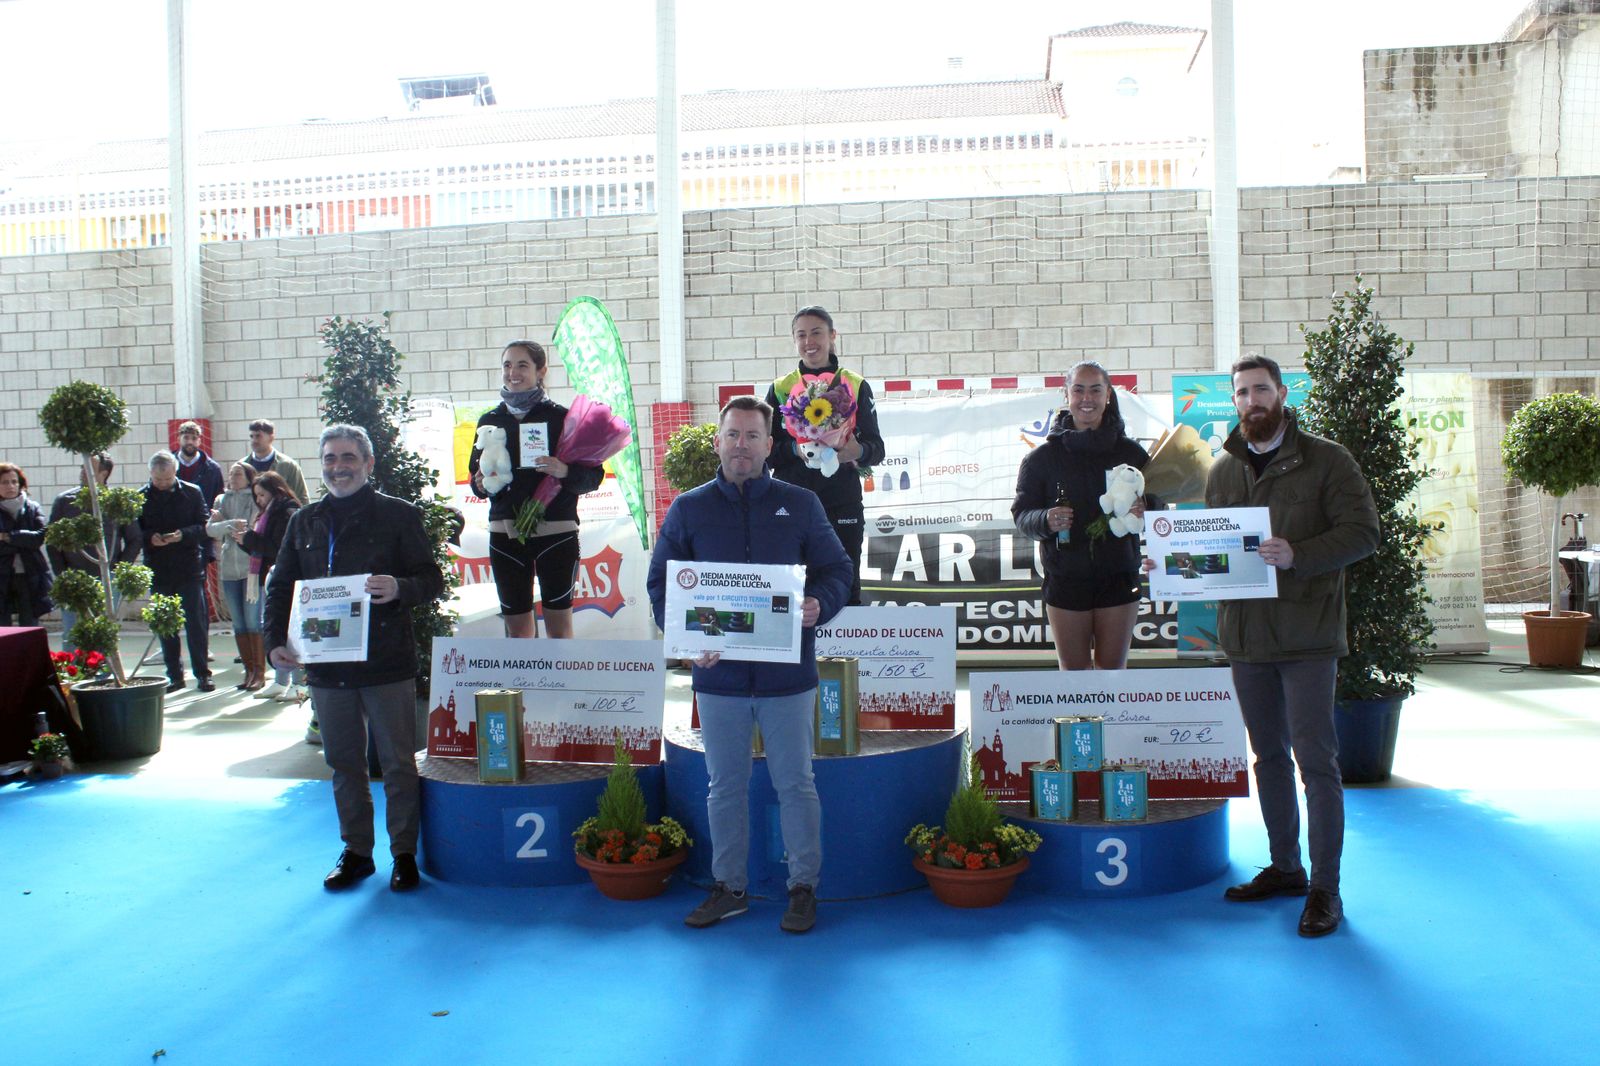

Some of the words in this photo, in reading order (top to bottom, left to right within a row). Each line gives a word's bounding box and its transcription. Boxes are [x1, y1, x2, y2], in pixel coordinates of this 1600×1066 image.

[928, 464, 980, 476] DEPORTES
[1173, 519, 1194, 527] MEDIA
[1195, 517, 1230, 525] MARATÓN
[700, 572, 724, 580] MEDIA
[725, 573, 761, 581] MARATÓN
[700, 579, 730, 587] CIUDAD
[742, 580, 771, 589] LUCENA
[835, 628, 878, 638] CIUDAD
[881, 628, 896, 638] DE
[899, 628, 944, 638] LUCENA
[828, 646, 886, 656] Cincuenta
[889, 645, 921, 656] Euros
[468, 658, 500, 669] MEDIA
[502, 658, 552, 670] MARATÓN
[555, 660, 594, 671] CIUDAD
[597, 661, 610, 671] DE
[613, 661, 655, 672] LUCENA
[877, 664, 905, 677] 150
[910, 663, 926, 678] €
[464, 680, 492, 688] cantidad
[512, 677, 536, 688] Cien
[537, 677, 566, 688] Euros
[592, 698, 617, 710] 100
[620, 697, 636, 711] €
[1015, 694, 1054, 705] MEDIA
[1056, 691, 1115, 704] MARATÓN
[1118, 692, 1164, 703] CIUDAD
[1167, 692, 1181, 702] DE
[1185, 691, 1231, 702] LUCENA
[1118, 710, 1150, 722] Euros
[1169, 729, 1192, 744] 90
[1196, 727, 1213, 743] €
[515, 812, 548, 858] 2
[1095, 837, 1128, 886] 3
